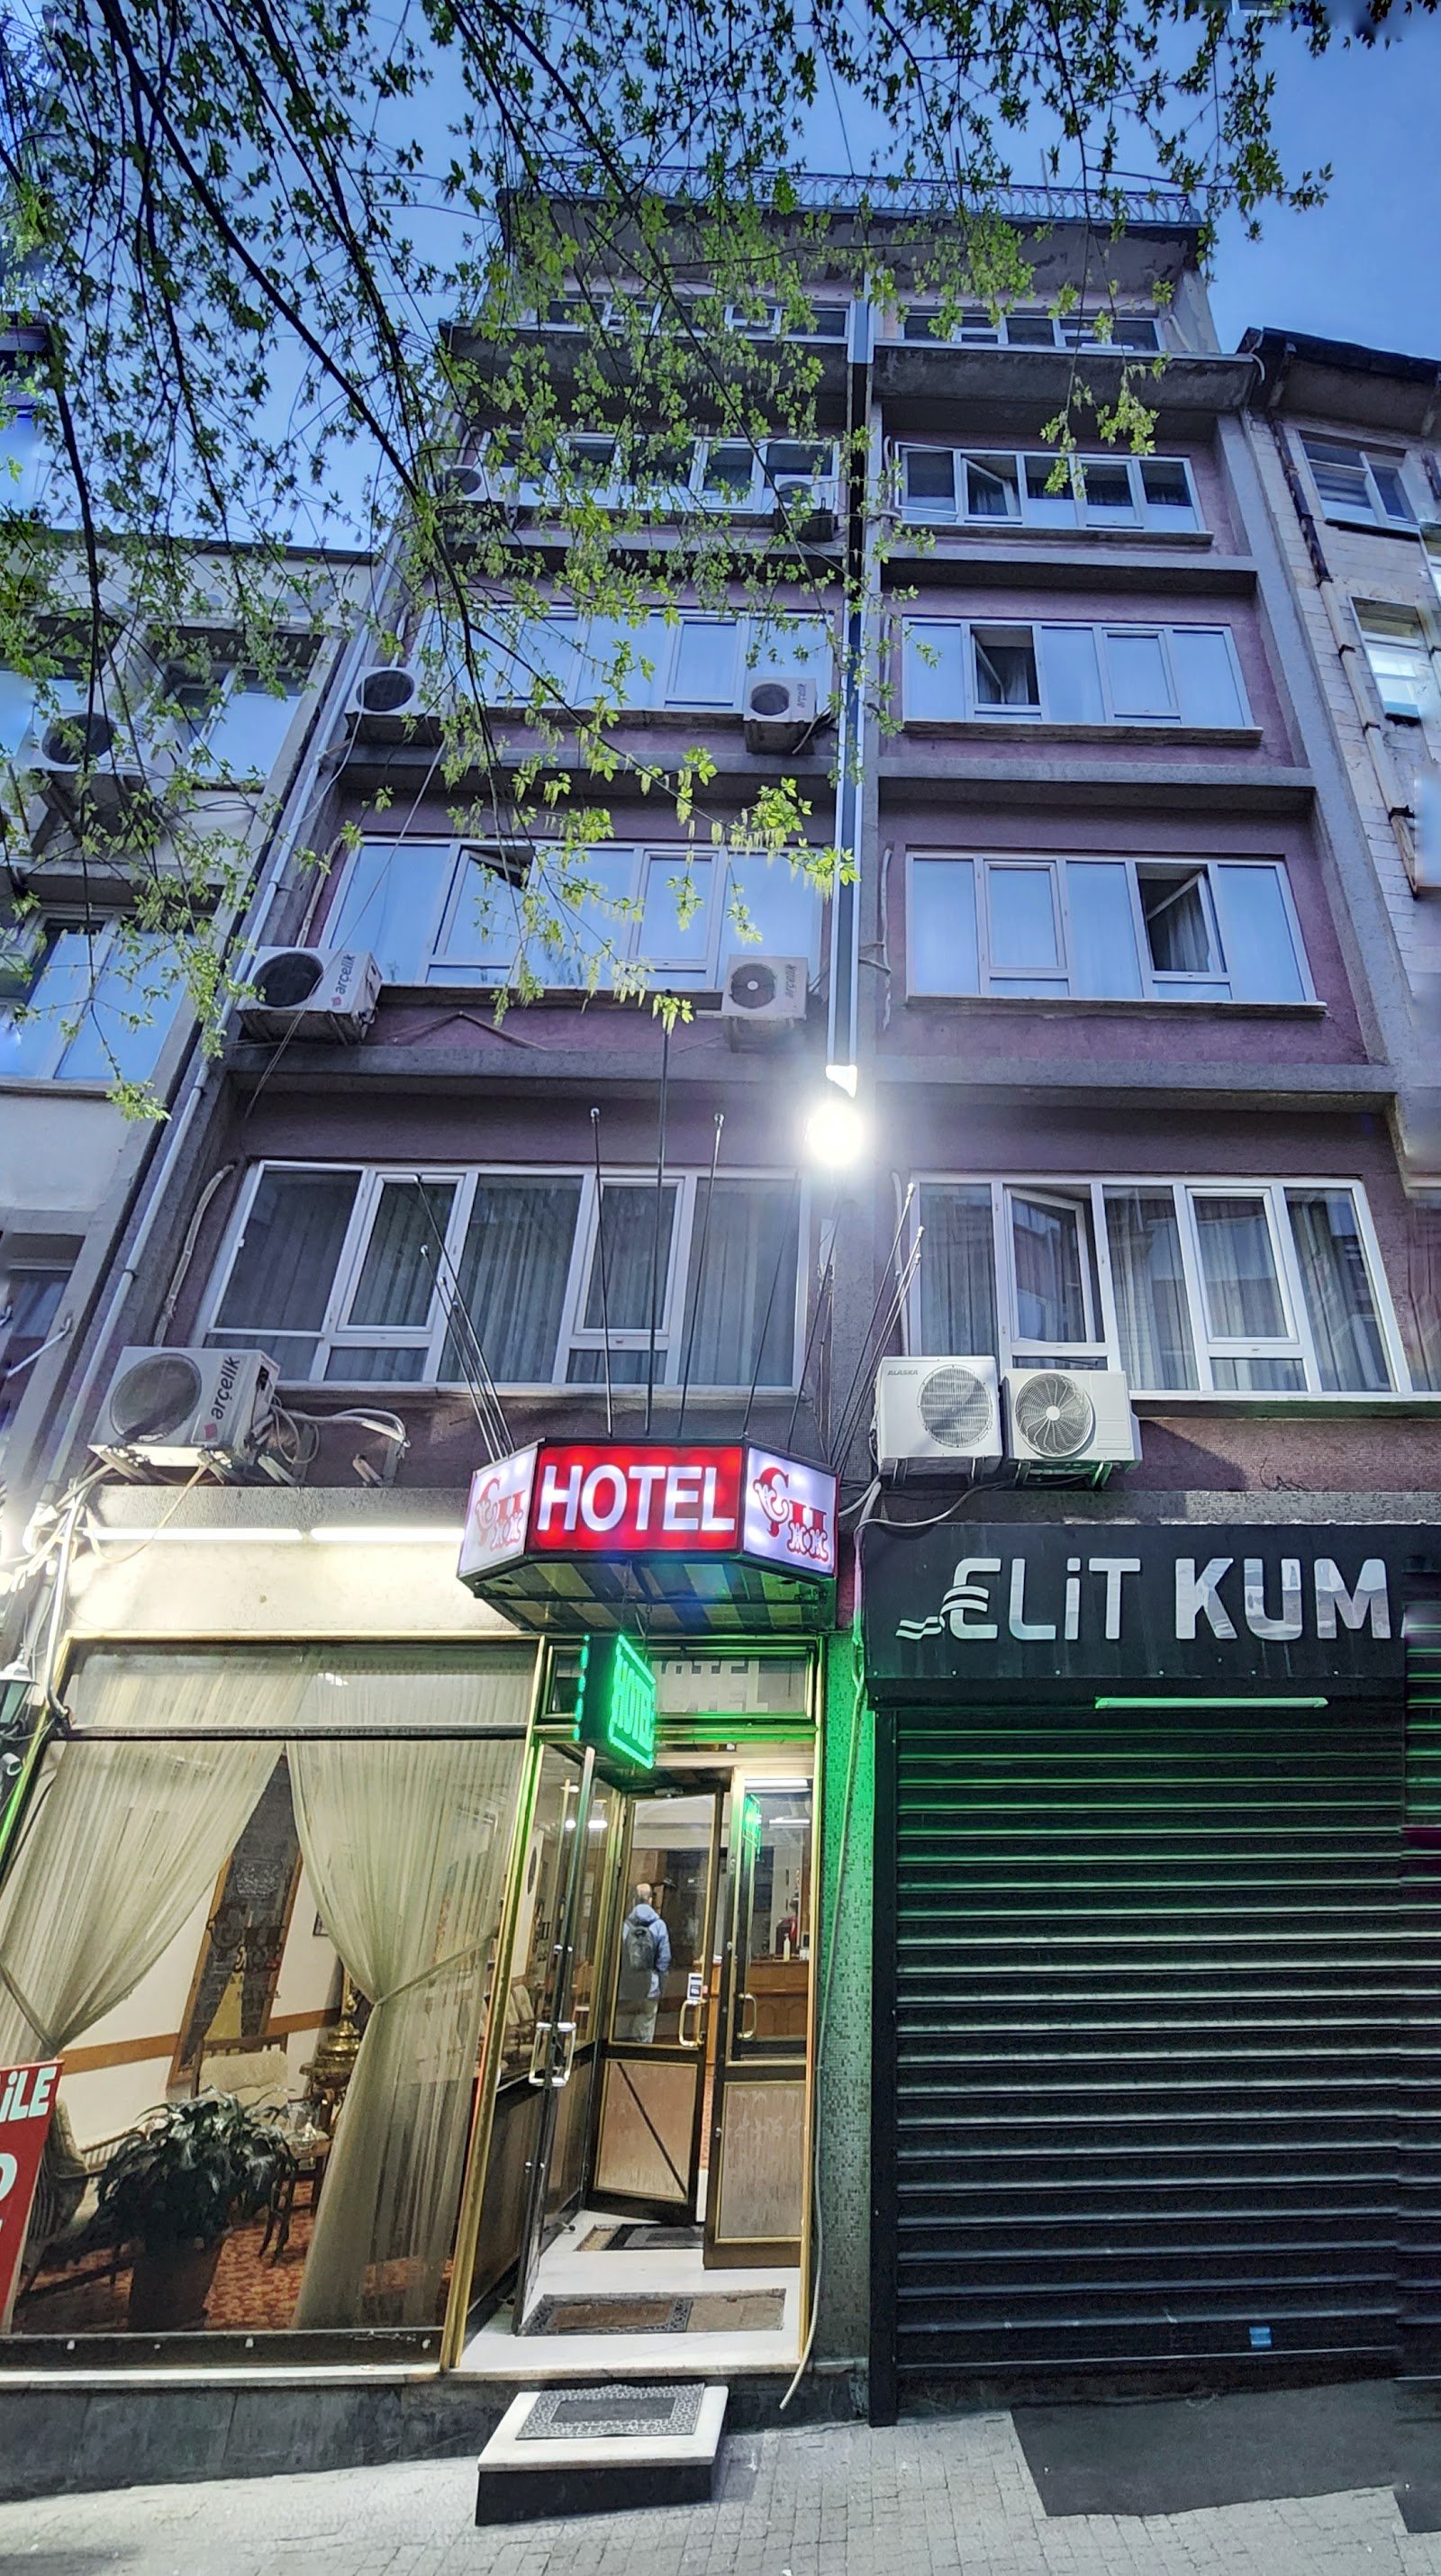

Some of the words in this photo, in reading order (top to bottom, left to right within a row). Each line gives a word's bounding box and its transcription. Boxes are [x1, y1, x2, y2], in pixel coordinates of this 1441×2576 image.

[335, 954, 357, 995] arçelik
[211, 1356, 240, 1420] arçelik
[537, 1465, 736, 1532] HOTEL
[1174, 1558, 1406, 1641] KUM
